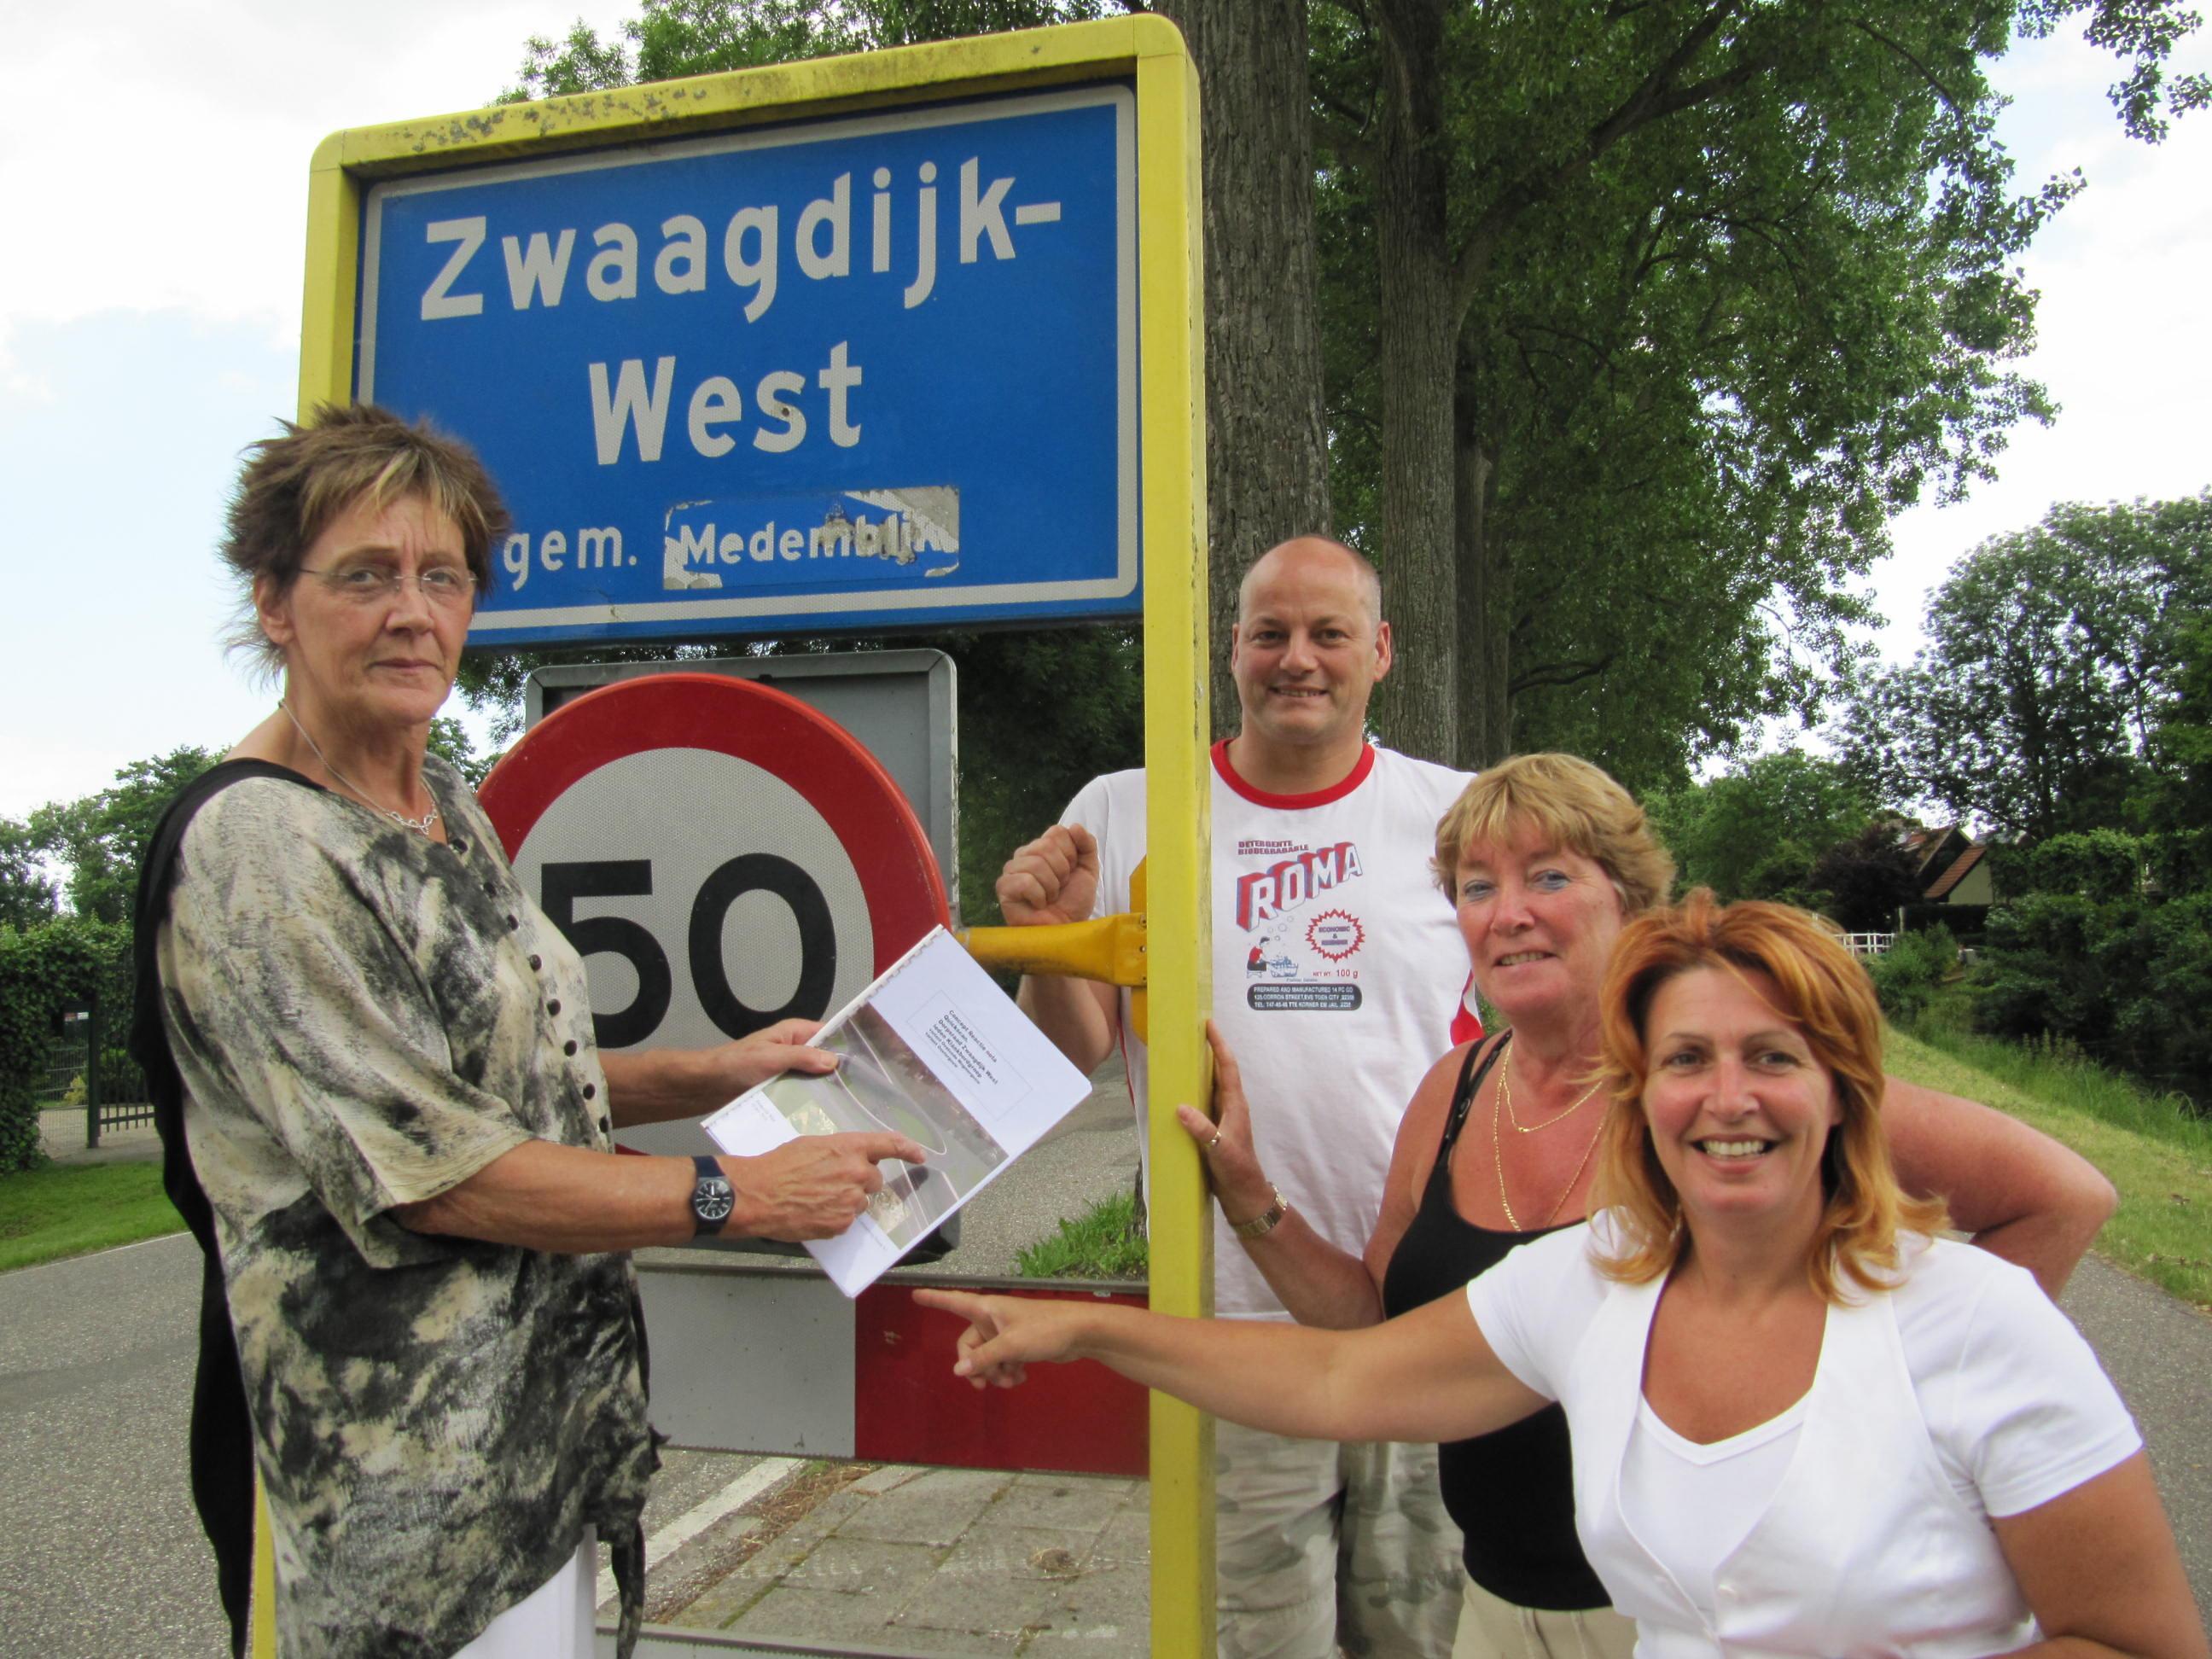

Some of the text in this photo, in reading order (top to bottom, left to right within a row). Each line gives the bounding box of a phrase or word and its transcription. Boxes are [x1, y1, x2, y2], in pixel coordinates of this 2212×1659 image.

[421, 155, 1062, 323] Zwaagdijk-
[588, 341, 863, 466] West
[504, 527, 637, 591] gem.
[1237, 841, 1364, 933] ROMA
[541, 853, 837, 1049] 50
[1336, 969, 1351, 977] 100
[1353, 970, 1359, 979] g
[949, 1010, 969, 1031] Concept
